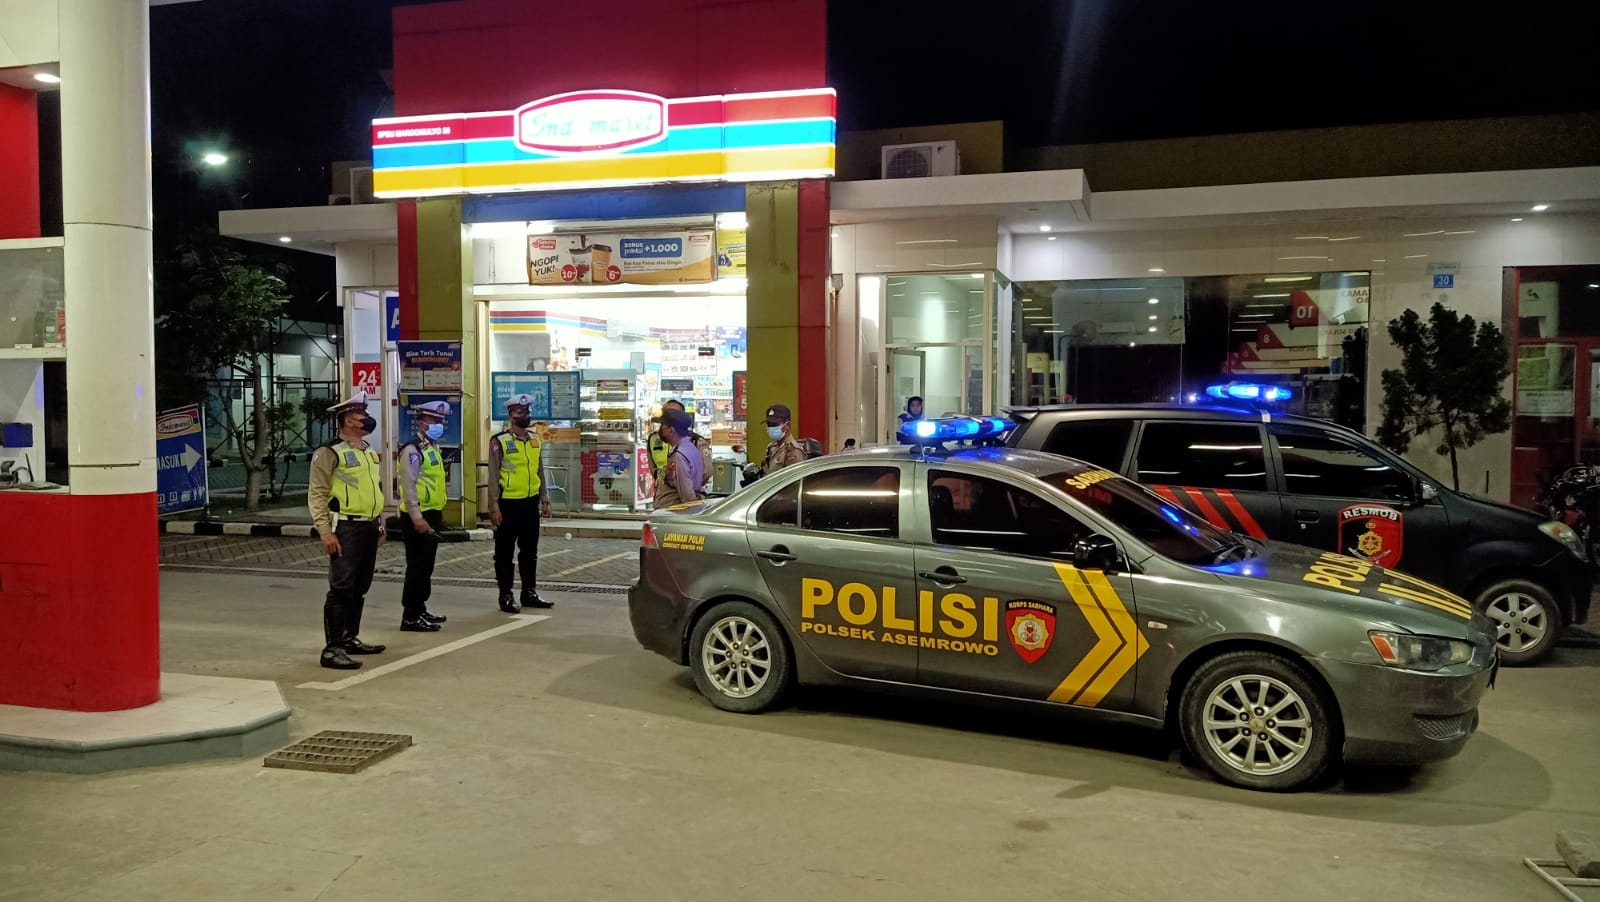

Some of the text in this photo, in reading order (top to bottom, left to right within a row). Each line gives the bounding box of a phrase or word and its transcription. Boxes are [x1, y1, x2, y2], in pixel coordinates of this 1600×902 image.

[528, 111, 654, 138] Indmaret
[530, 255, 559, 268] NGOPI
[534, 265, 555, 276] YUK!
[1438, 275, 1449, 285] 30
[358, 370, 377, 386] 24
[1343, 507, 1398, 521] RESMOB
[801, 577, 998, 642] POLISI
[1028, 601, 1054, 614] SABHARA
[801, 622, 999, 656] POLSEK ASEMROWO
